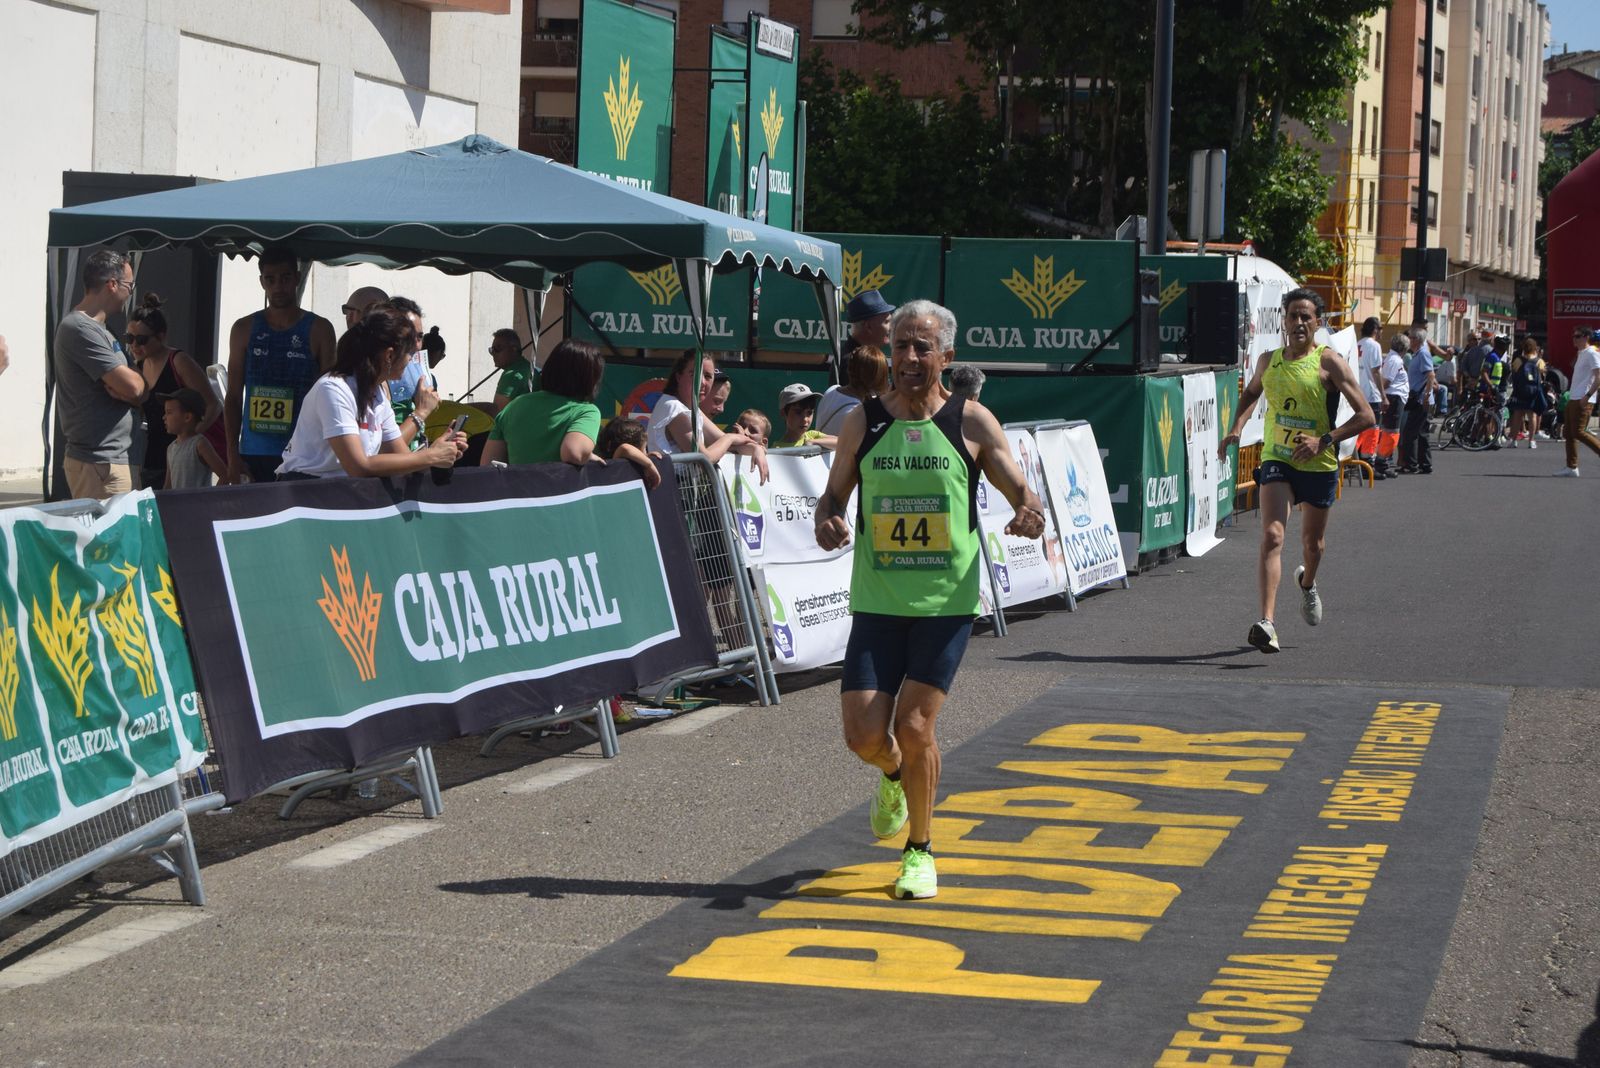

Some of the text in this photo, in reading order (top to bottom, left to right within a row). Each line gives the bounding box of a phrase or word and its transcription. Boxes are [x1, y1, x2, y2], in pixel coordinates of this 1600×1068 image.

[589, 311, 644, 334] CAJA
[774, 318, 830, 340] CAJA
[966, 327, 1120, 350] CAJA RURAL
[252, 400, 286, 419] 128
[873, 456, 950, 470] MESA VALORIO
[890, 517, 931, 547] 44
[1065, 523, 1119, 572] OCEANIC
[895, 556, 946, 565] CAJA RURAL
[394, 552, 622, 662] CAJA RURAL
[1348, 701, 1442, 766] INTERIORES
[10, 747, 49, 784] RURAL
[1318, 769, 1418, 822] DISEÑO
[668, 723, 1306, 1003] PIDEPAR
[1242, 844, 1389, 942] INTEGRAL
